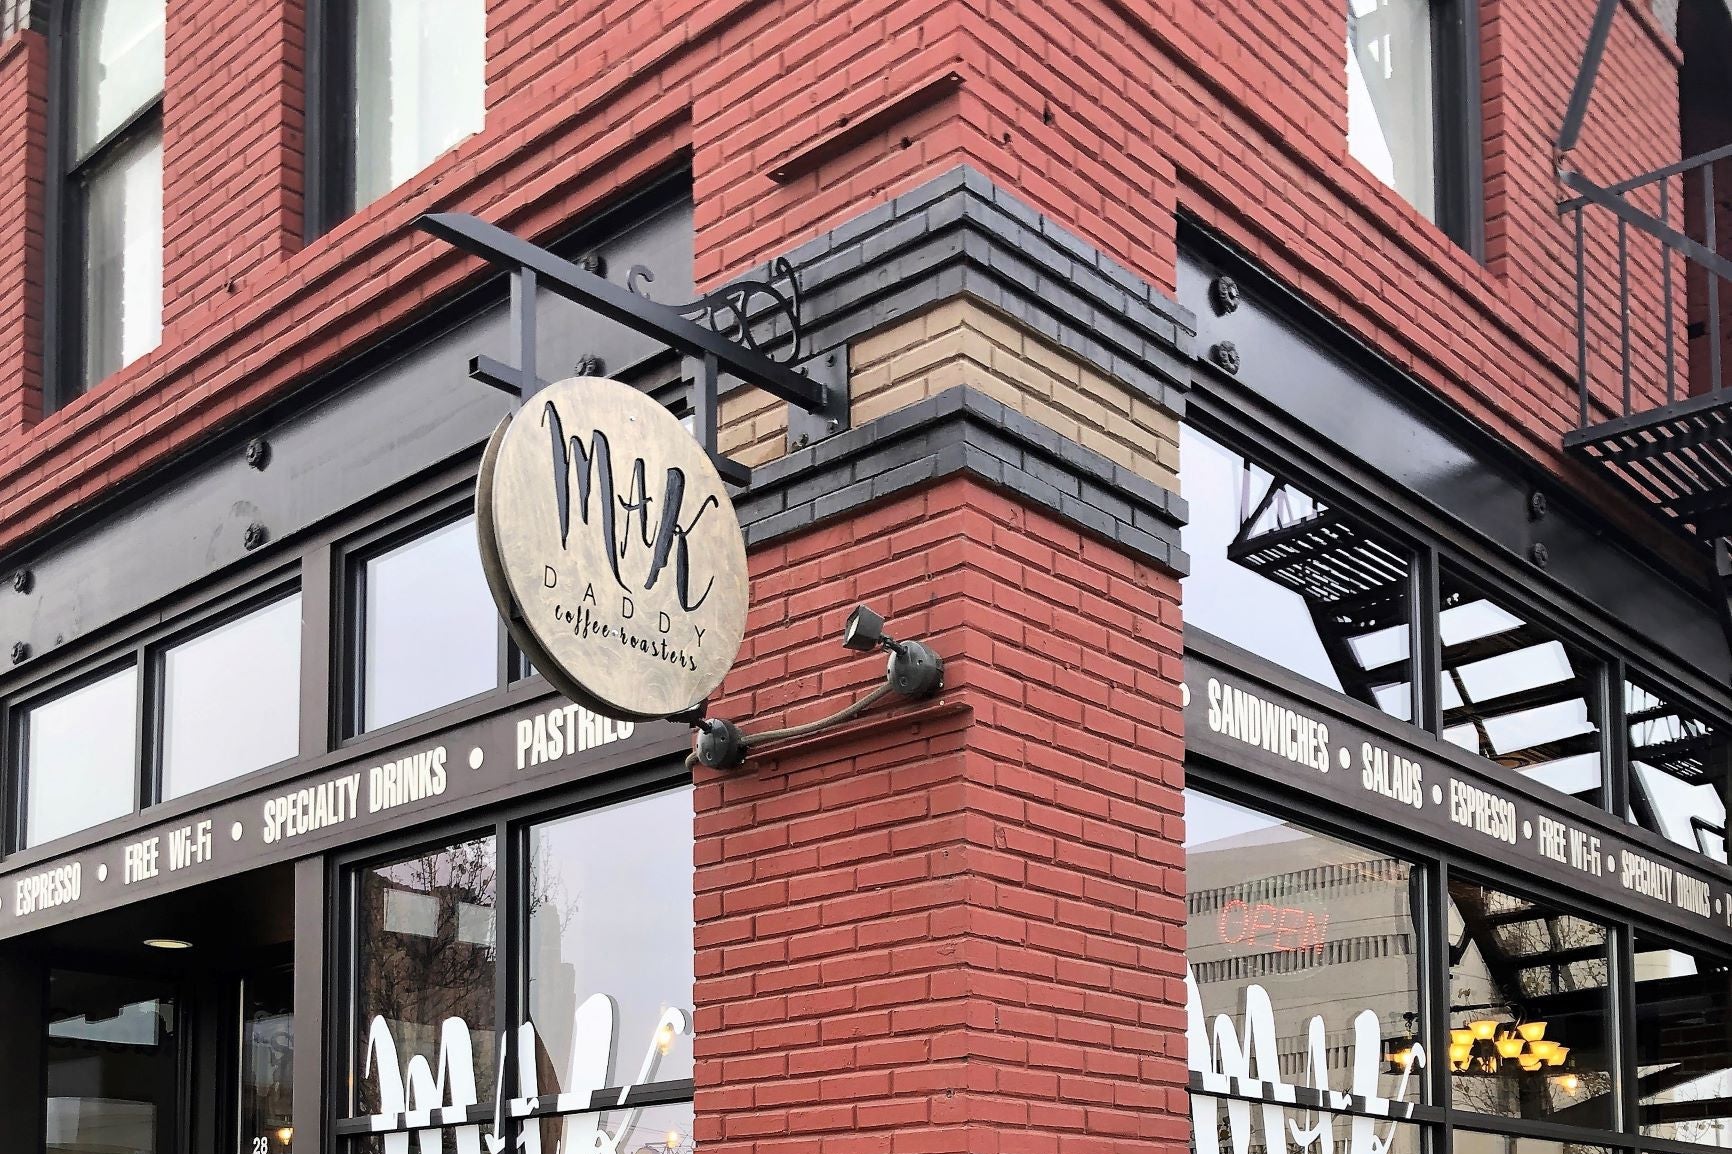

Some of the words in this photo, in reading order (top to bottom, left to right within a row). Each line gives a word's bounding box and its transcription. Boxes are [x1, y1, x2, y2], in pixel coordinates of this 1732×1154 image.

[544, 565, 706, 647] DADDY
[555, 604, 611, 639] coffee
[620, 626, 697, 671] roasters
[15, 862, 82, 917] ESPRESSO
[124, 836, 160, 885] FREE
[168, 819, 213, 872] Wi-Fi
[263, 772, 361, 844] SPECIALTY
[369, 746, 448, 814] DRINKS
[1208, 677, 1330, 774] SANDWICHES
[1362, 741, 1423, 810] SALADS
[1450, 777, 1517, 845] ESPRESSO
[1538, 814, 1567, 864] FREE
[1569, 827, 1602, 877] Wi-Fi
[1621, 849, 1673, 904] SPECIALTY
[1676, 871, 1711, 919] DRINKS
[1220, 899, 1330, 955] OPEN
